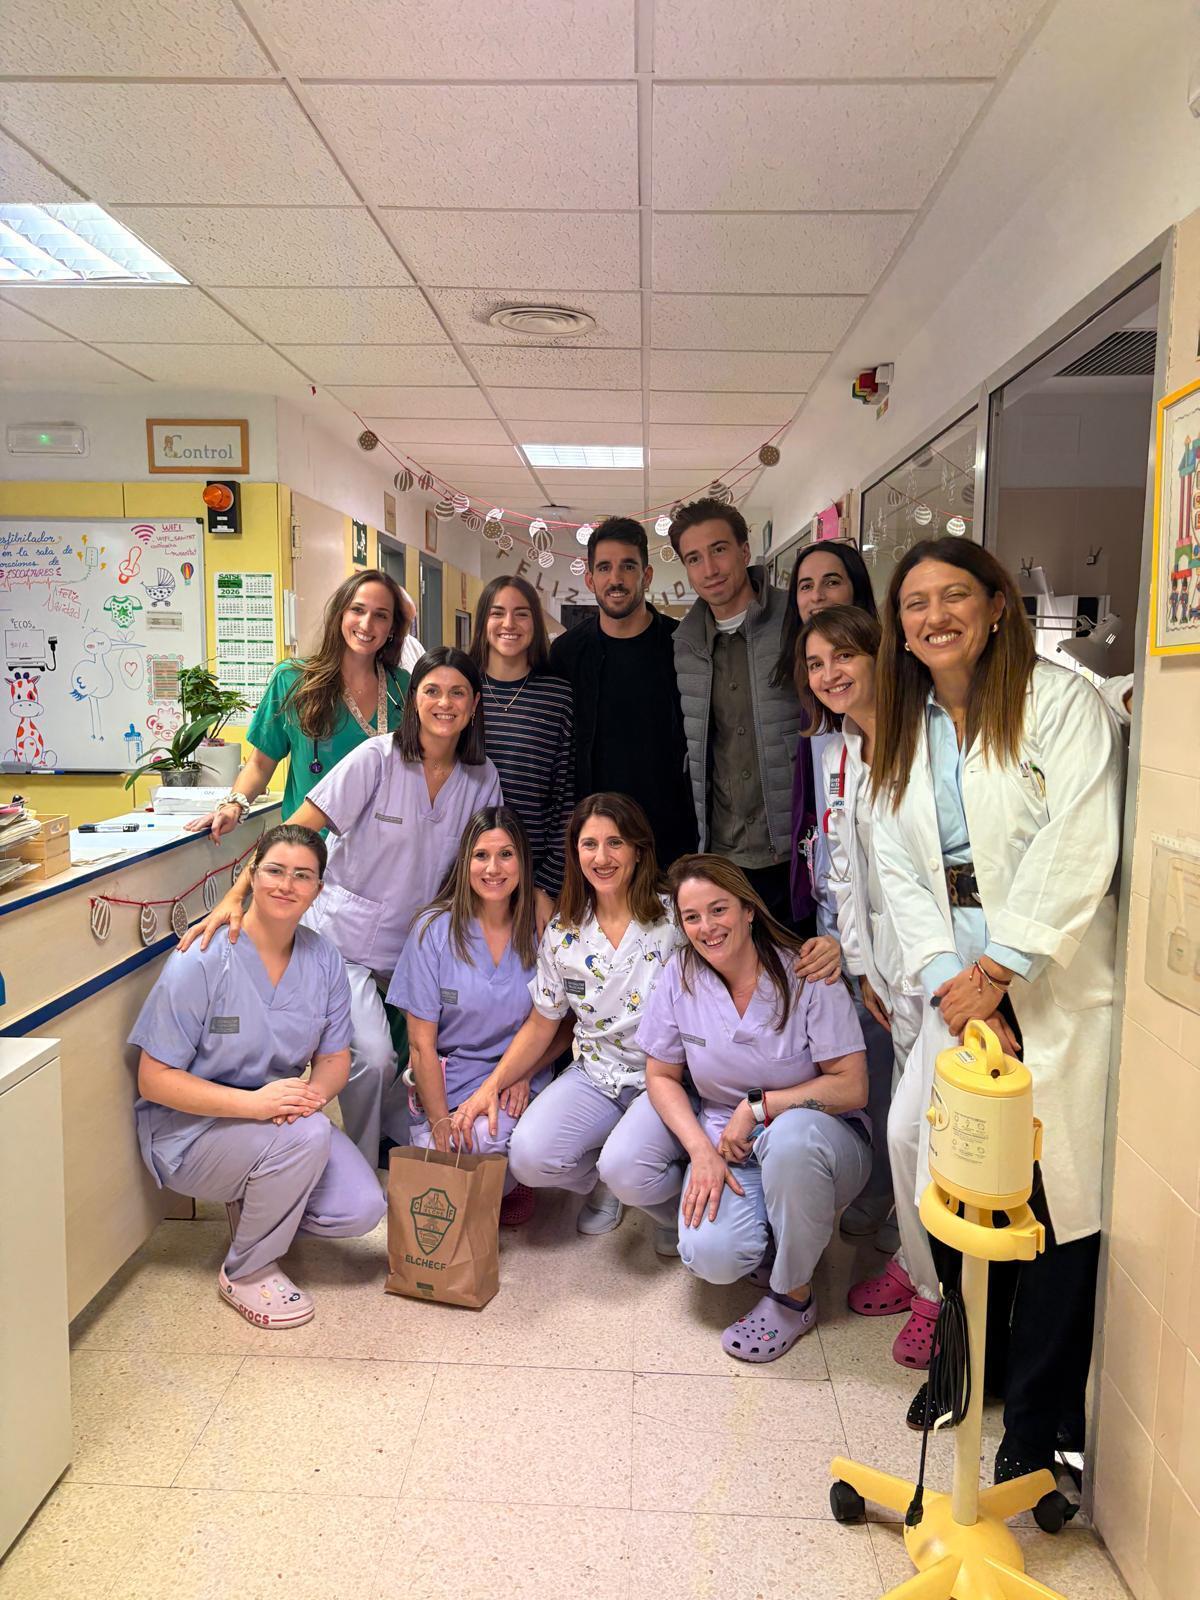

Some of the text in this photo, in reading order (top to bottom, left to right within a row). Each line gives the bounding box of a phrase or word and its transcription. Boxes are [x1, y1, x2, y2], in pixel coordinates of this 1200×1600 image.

[163, 434, 233, 459] Control
[162, 524, 182, 532] WIFI
[16, 547, 29, 557] la
[36, 547, 55, 556] sala
[63, 545, 73, 555] de
[49, 556, 60, 566] de
[239, 1304, 270, 1325] crocs
